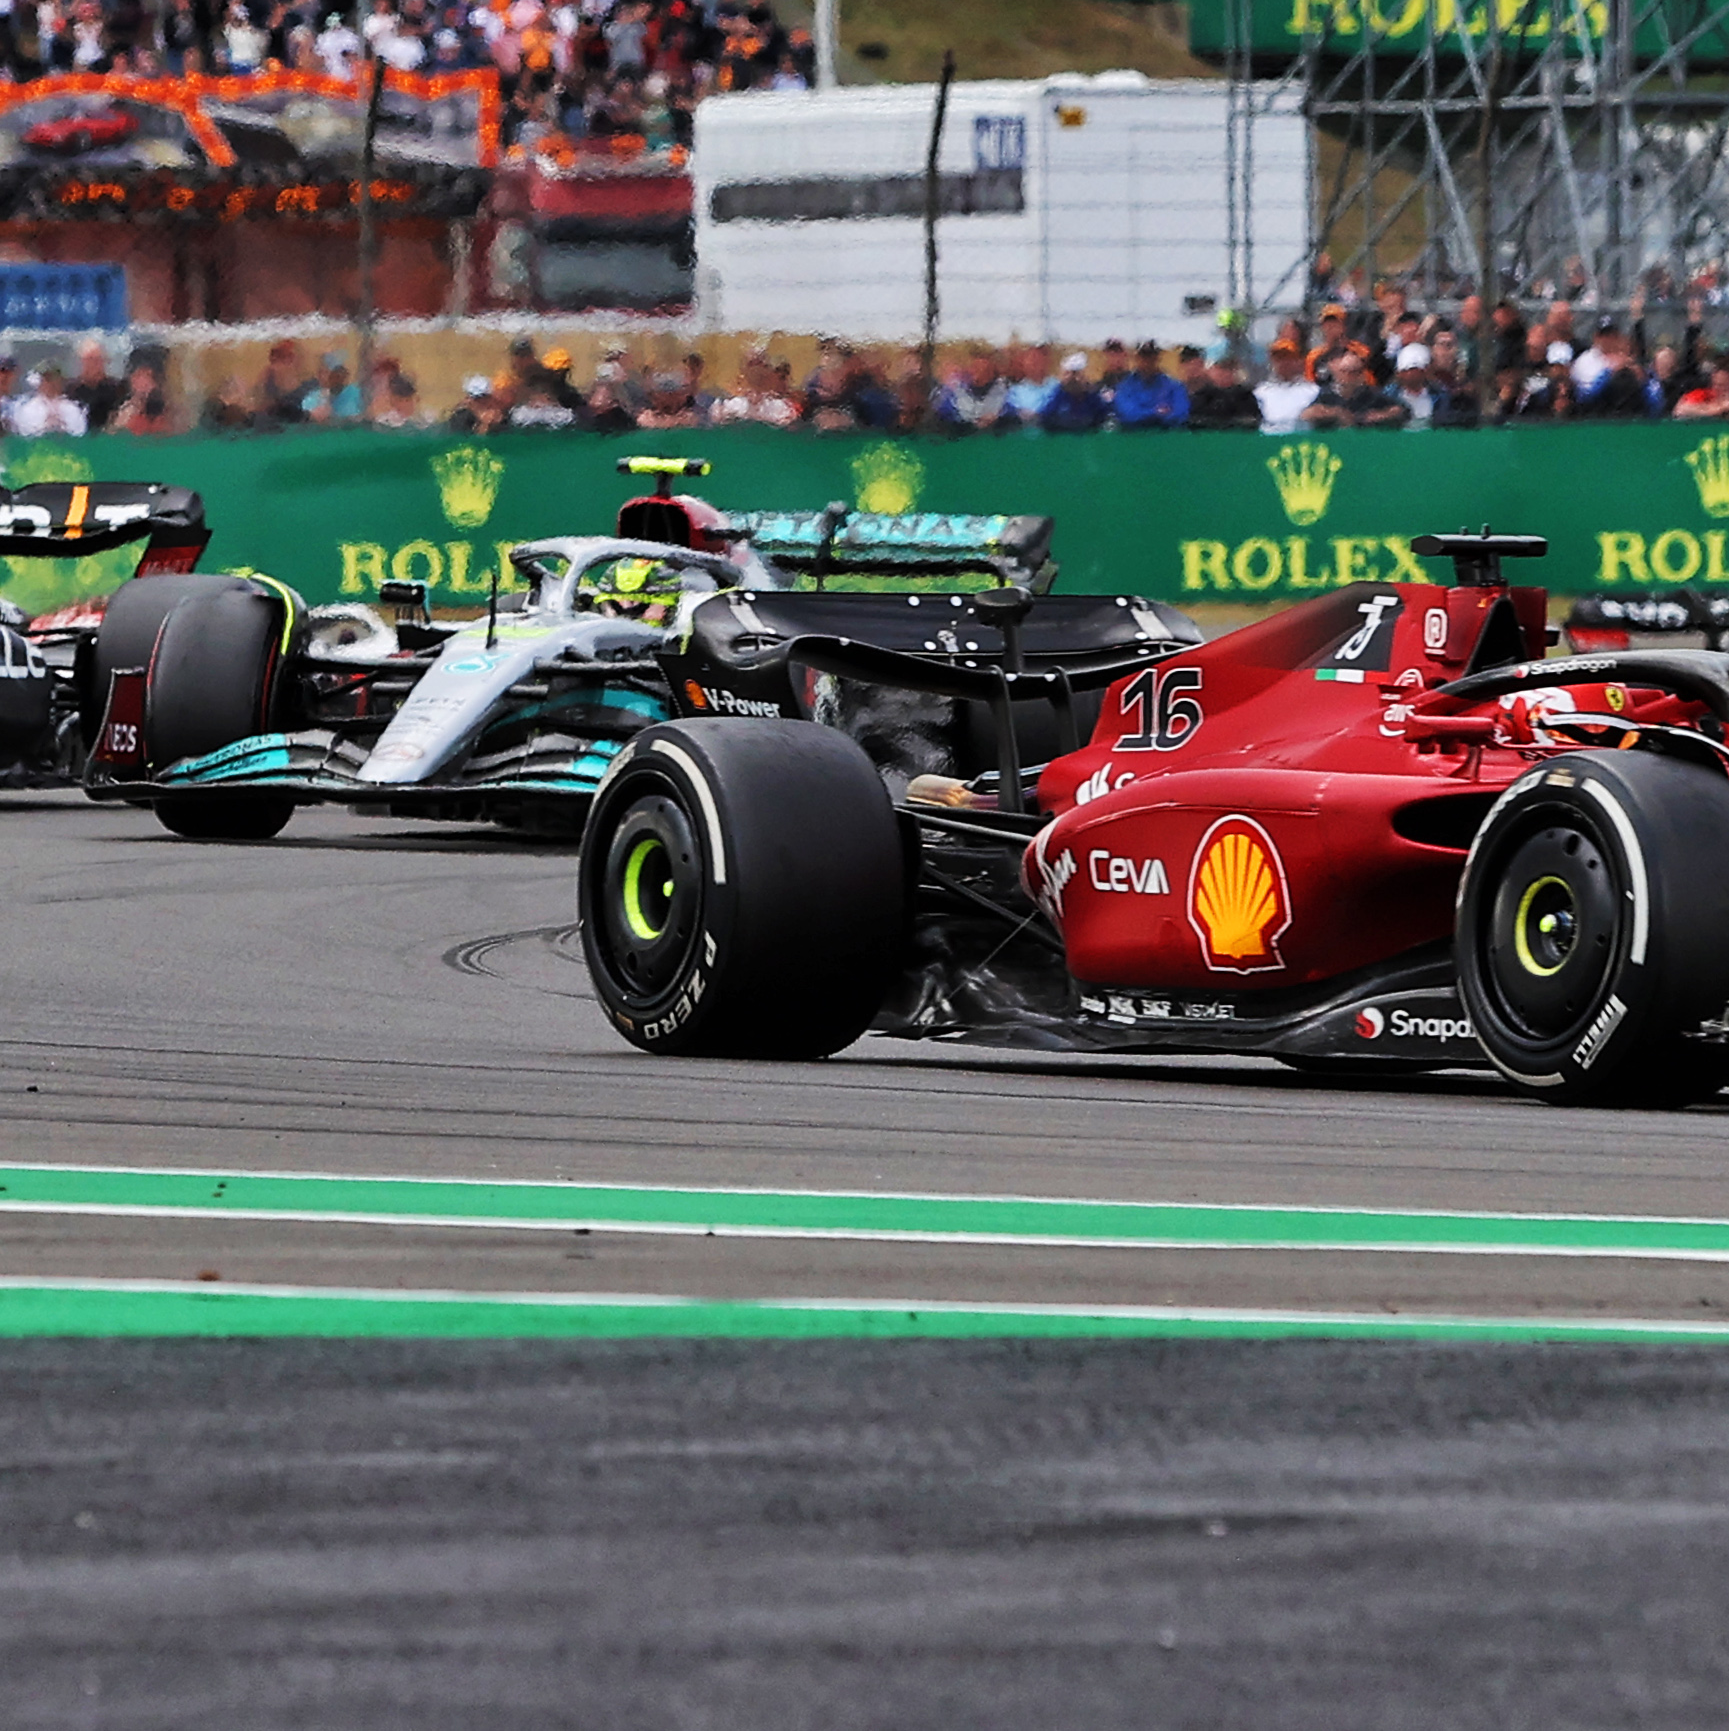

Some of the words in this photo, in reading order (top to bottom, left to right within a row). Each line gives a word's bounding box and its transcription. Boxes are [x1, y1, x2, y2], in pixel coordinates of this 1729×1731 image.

[1180, 535, 1434, 590] ROLEX
[1530, 658, 1619, 676] Snapdragon
[701, 686, 781, 719] V-Power
[1112, 667, 1203, 752] 16
[643, 968, 707, 1041] ZERO
